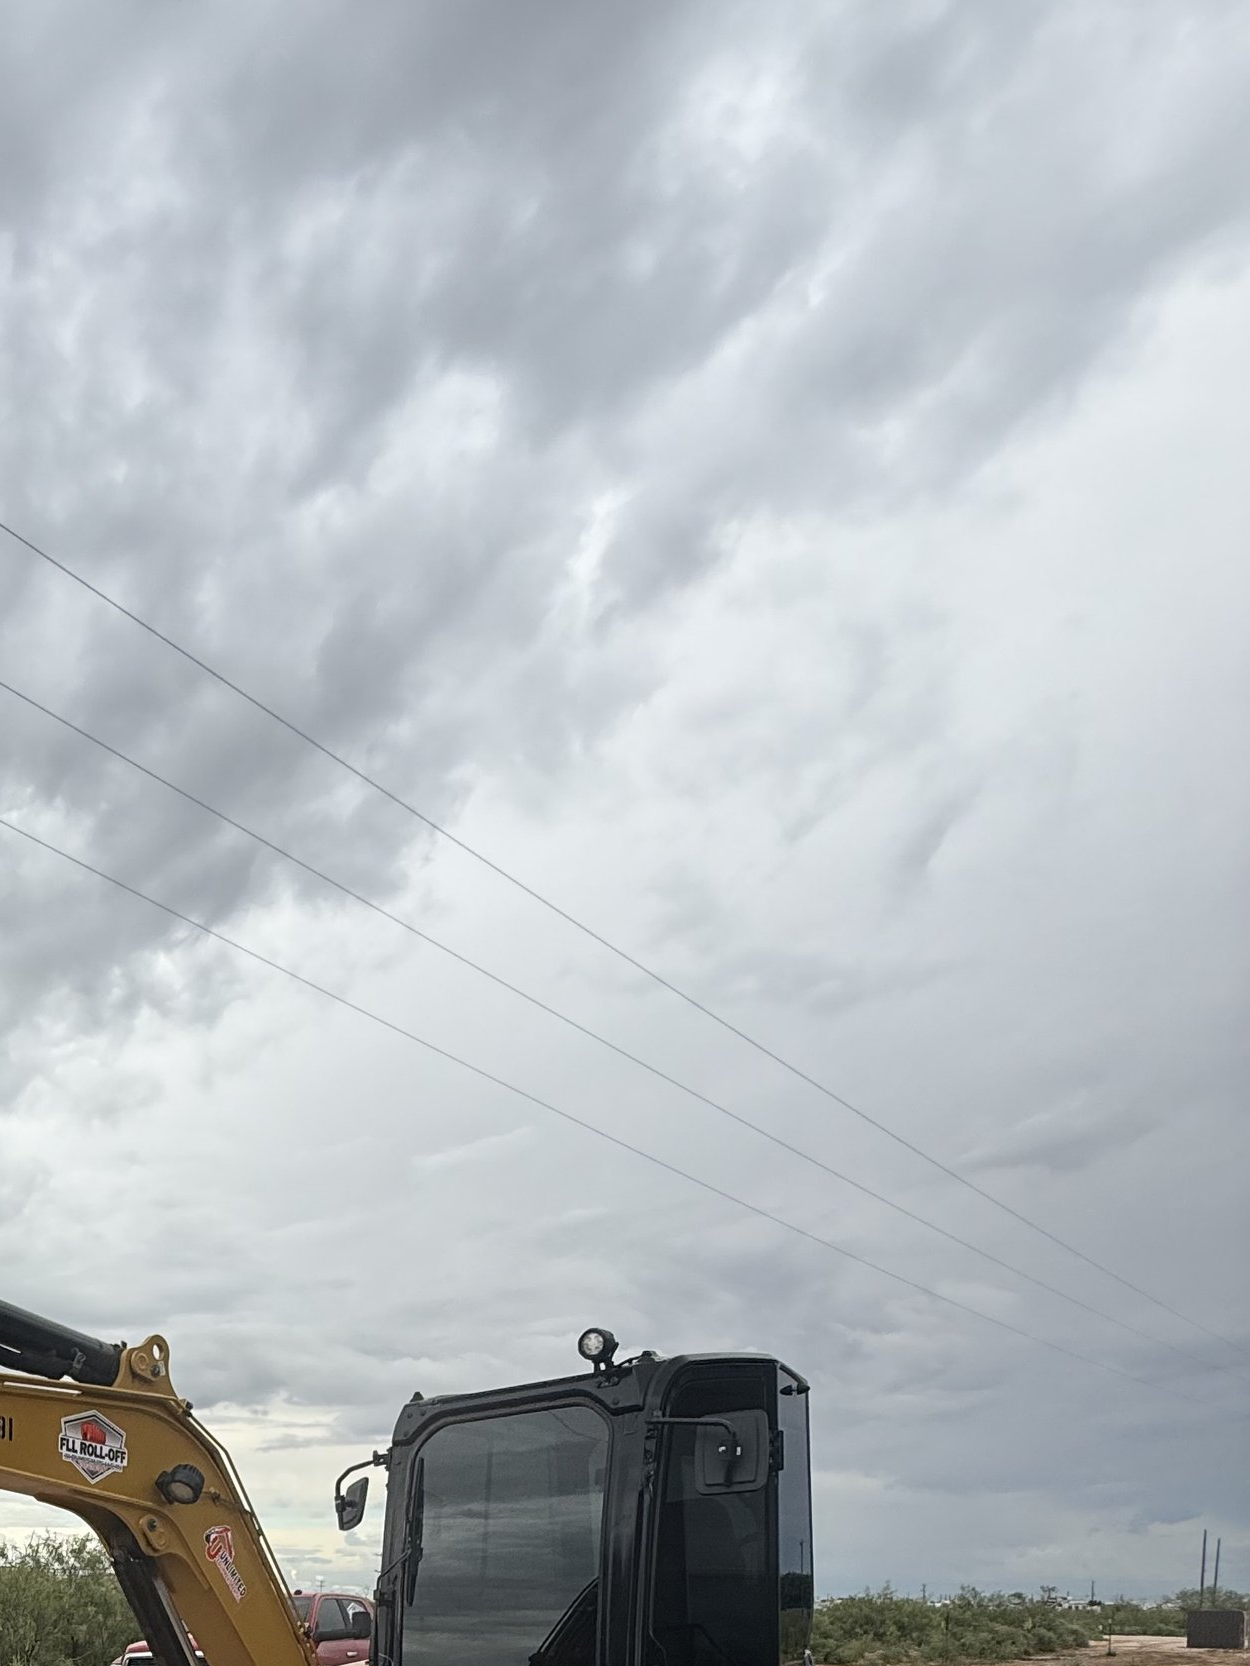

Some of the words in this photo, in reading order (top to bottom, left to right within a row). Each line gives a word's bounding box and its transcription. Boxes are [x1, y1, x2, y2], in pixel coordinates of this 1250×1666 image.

[60, 1437, 78, 1454] FLL
[80, 1441, 127, 1464] ROLL-OFF
[220, 1551, 247, 1596] UNLIMITED
